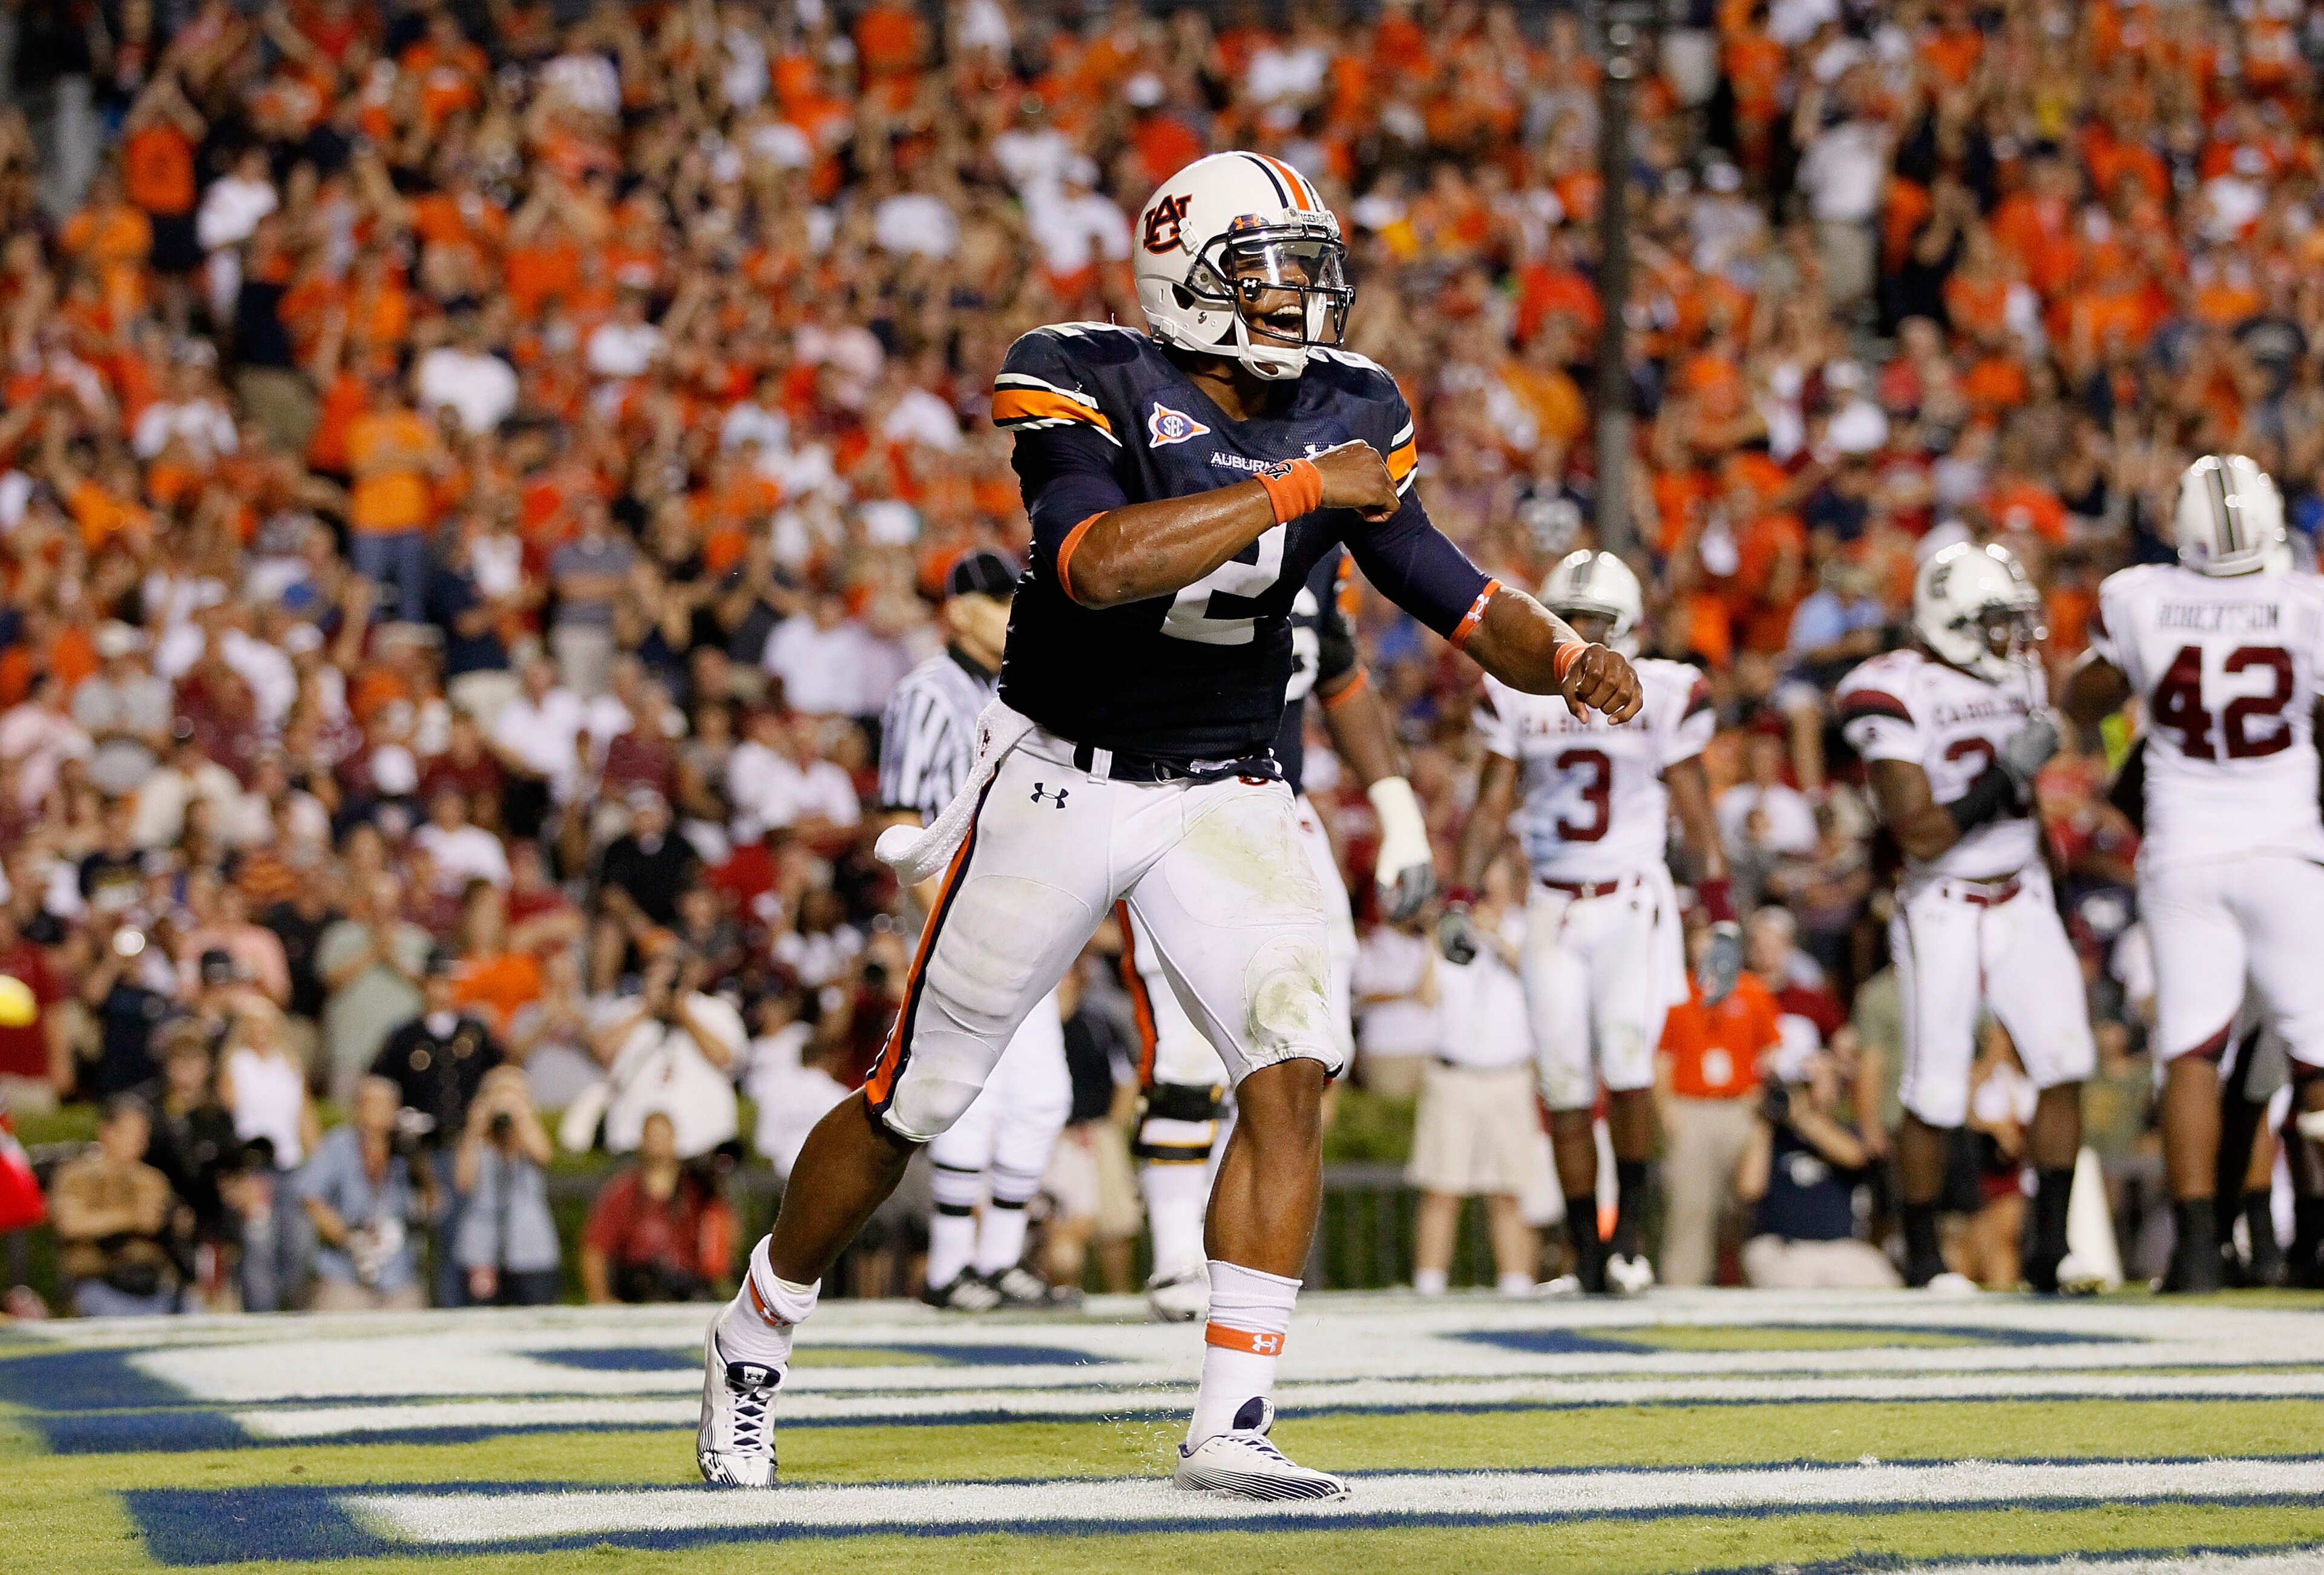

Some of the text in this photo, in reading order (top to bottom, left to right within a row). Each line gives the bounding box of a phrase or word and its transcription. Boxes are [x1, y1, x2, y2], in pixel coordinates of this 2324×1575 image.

[1163, 416, 1184, 437] SEC
[1160, 522, 1287, 646] 2
[2153, 646, 2294, 761] 42
[1557, 749, 1611, 842] 3
